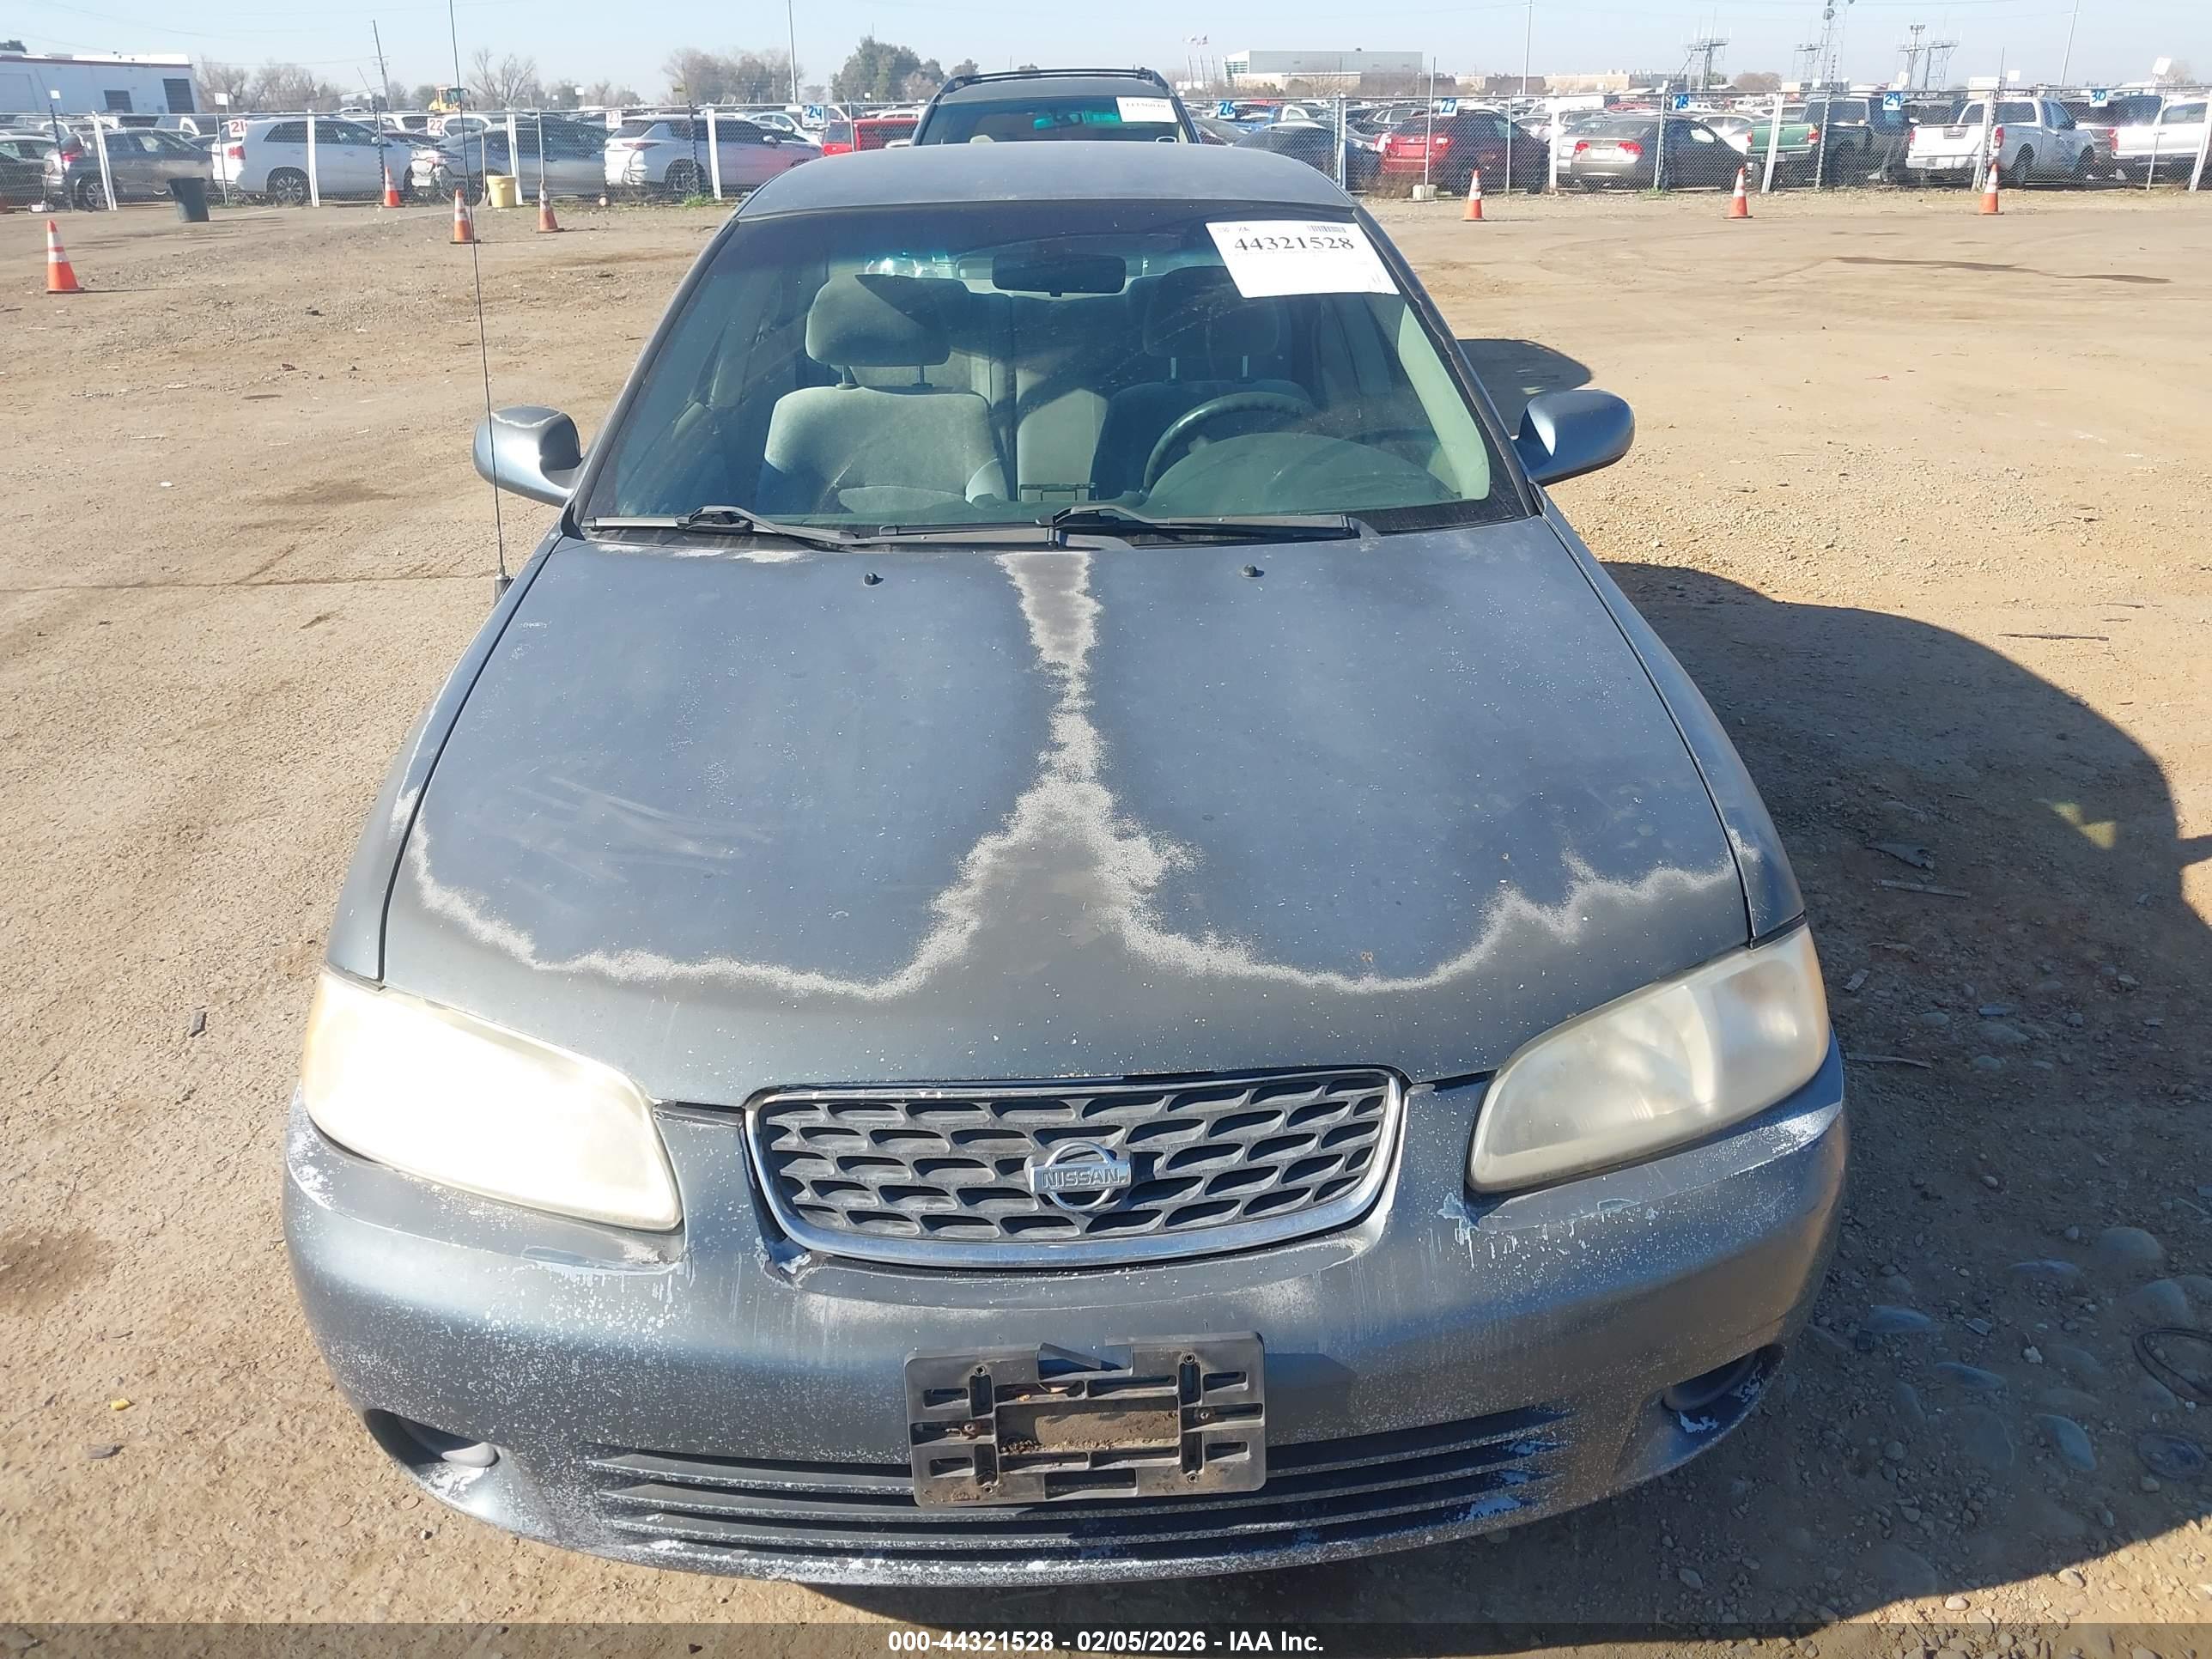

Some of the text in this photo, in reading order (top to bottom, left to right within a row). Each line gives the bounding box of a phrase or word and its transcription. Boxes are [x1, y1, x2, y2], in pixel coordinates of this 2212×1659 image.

[1674, 95, 1688, 108] 28
[1885, 94, 1900, 106] 29
[2092, 90, 2106, 103] 30
[1218, 101, 1236, 116] 26
[1442, 98, 1456, 112] 27
[809, 106, 823, 119] 24
[231, 121, 245, 132] 21
[429, 120, 442, 131] 22
[1234, 236, 1354, 251] 44321528
[1042, 1167, 1121, 1189] NISSAN
